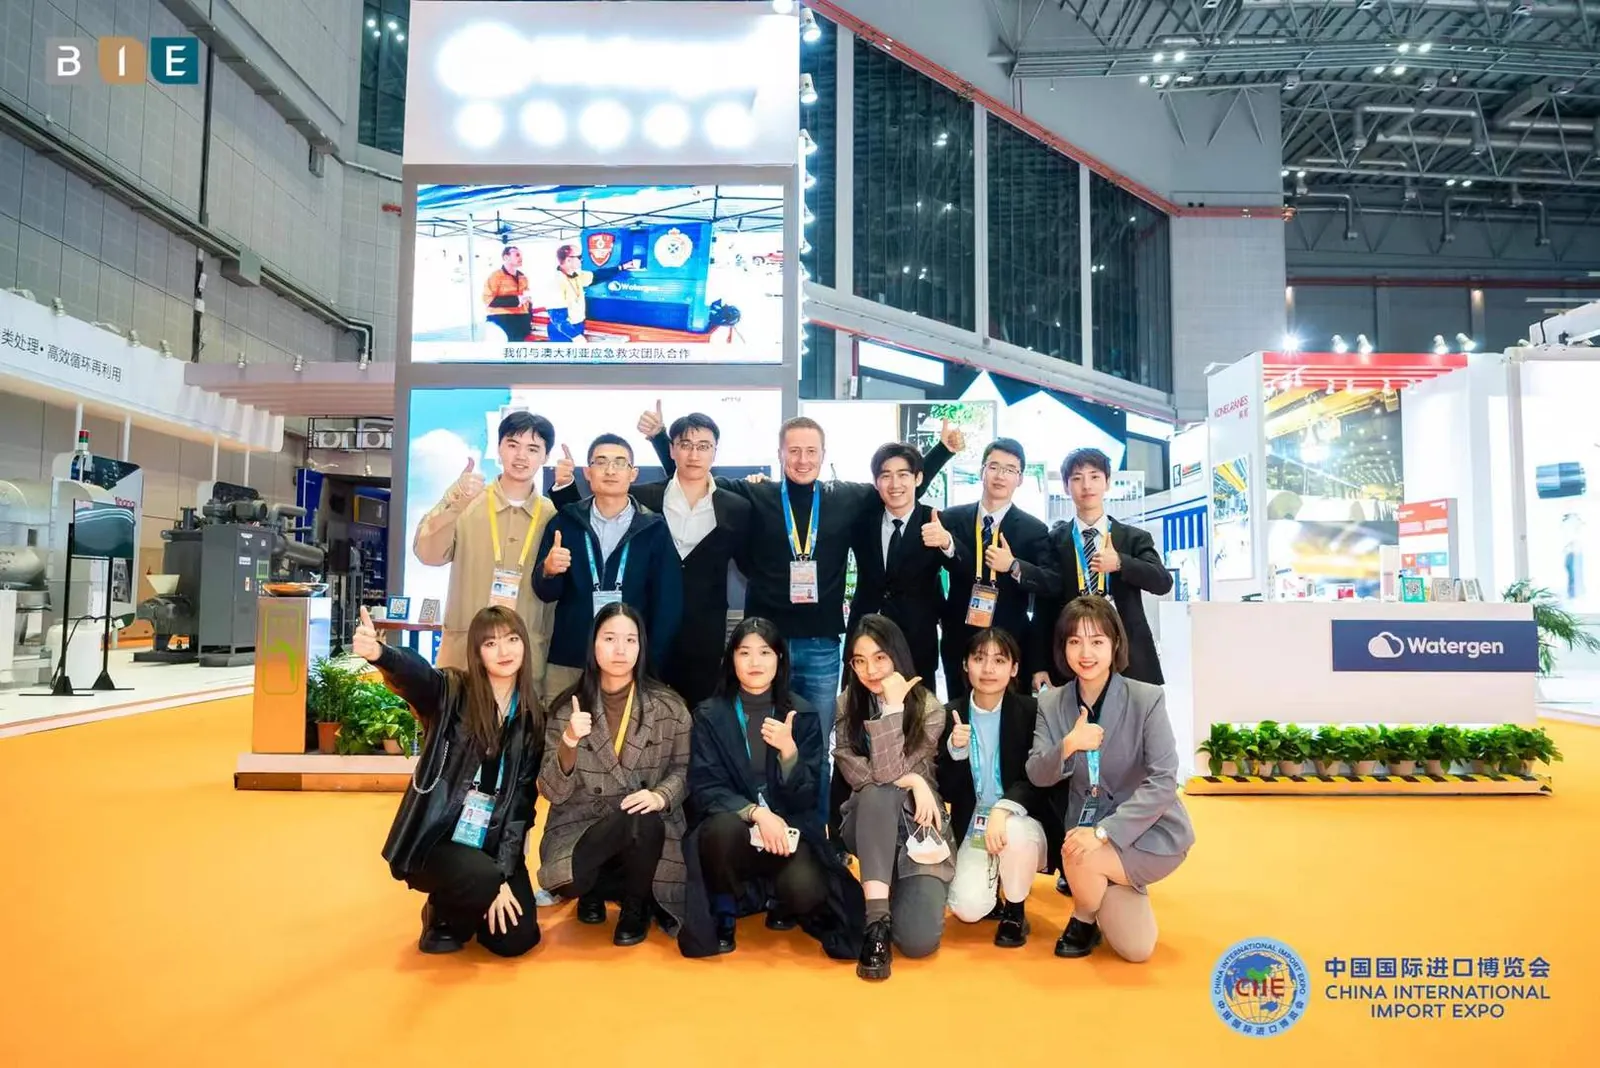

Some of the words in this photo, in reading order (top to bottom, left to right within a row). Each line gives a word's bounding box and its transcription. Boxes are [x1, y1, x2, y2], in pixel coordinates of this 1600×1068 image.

[503, 347, 690, 360] 我们与澳大利亚应急救灾团队合作
[1407, 637, 1504, 658] Watergen
